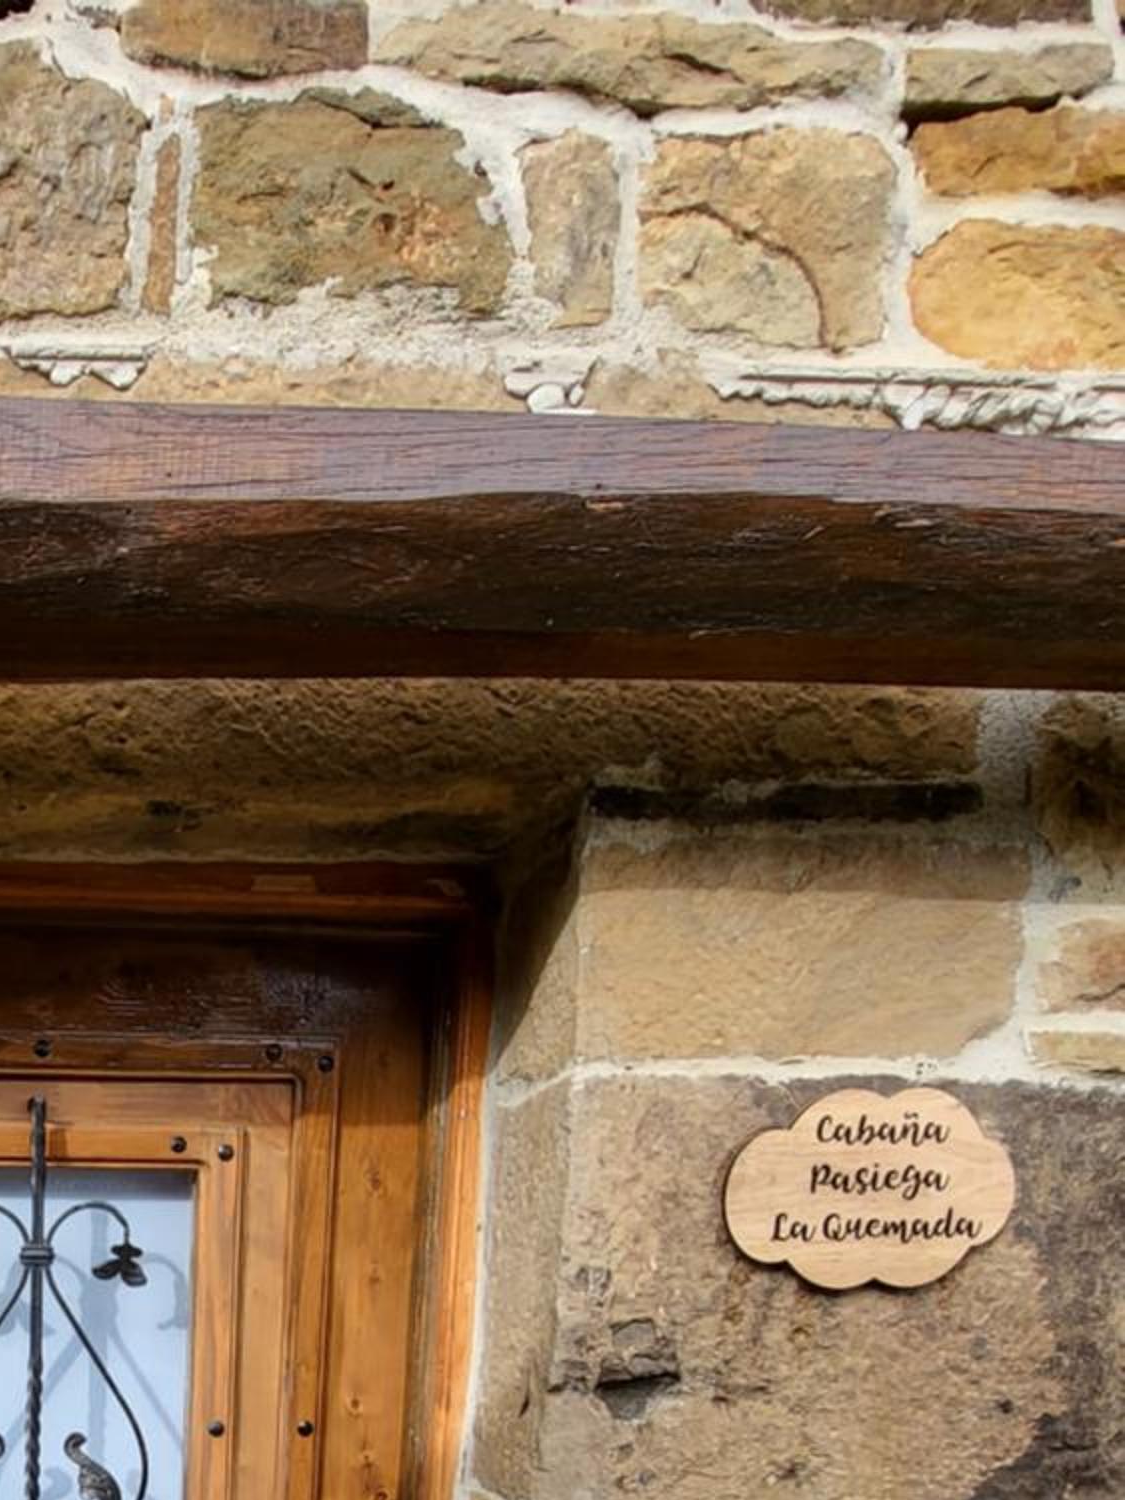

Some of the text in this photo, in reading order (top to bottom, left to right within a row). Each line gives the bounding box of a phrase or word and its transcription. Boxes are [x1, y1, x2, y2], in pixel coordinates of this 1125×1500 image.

[816, 1112, 950, 1147] Cabaña
[810, 1163, 950, 1200] Pasiega
[771, 1207, 982, 1244] La Quemada
